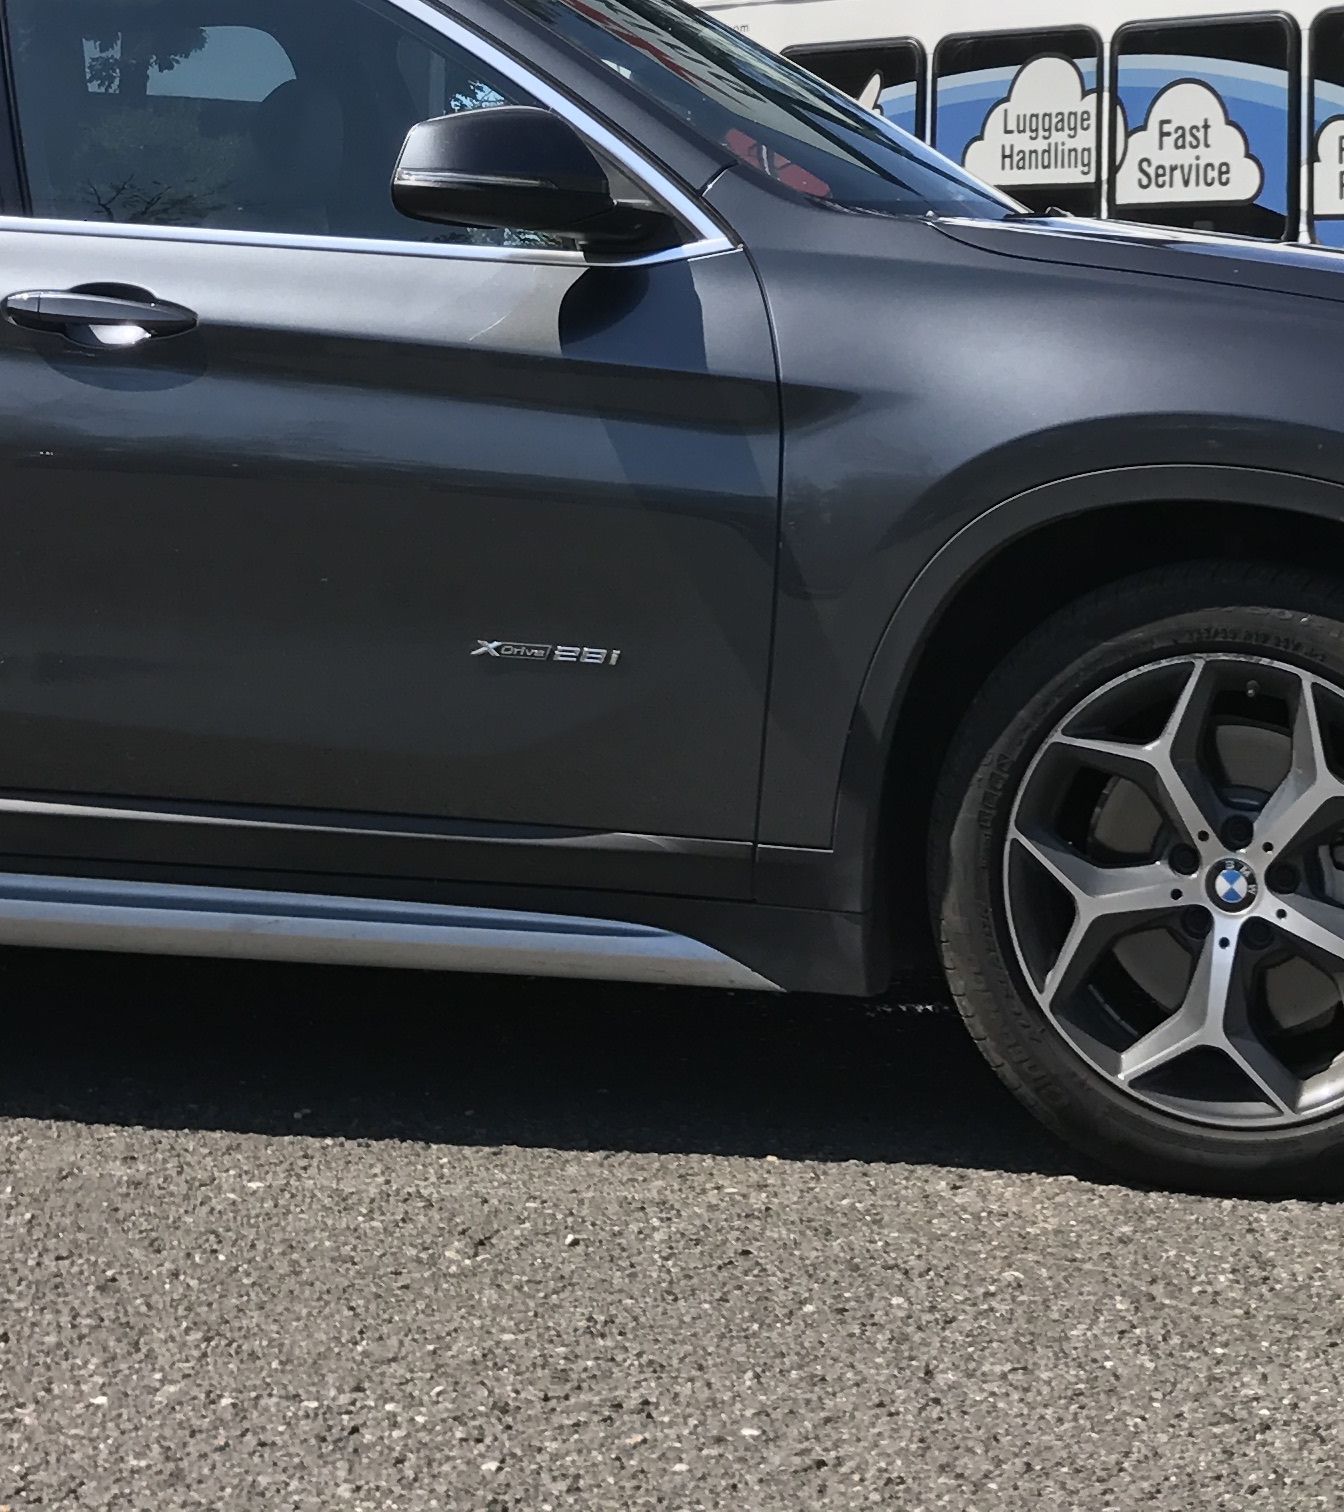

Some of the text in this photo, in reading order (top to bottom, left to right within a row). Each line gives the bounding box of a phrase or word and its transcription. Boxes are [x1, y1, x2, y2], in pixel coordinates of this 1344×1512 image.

[1003, 108, 1091, 140] Luggage
[1158, 117, 1211, 151] Fast
[1001, 141, 1092, 176] Handling
[1137, 154, 1231, 189] Service
